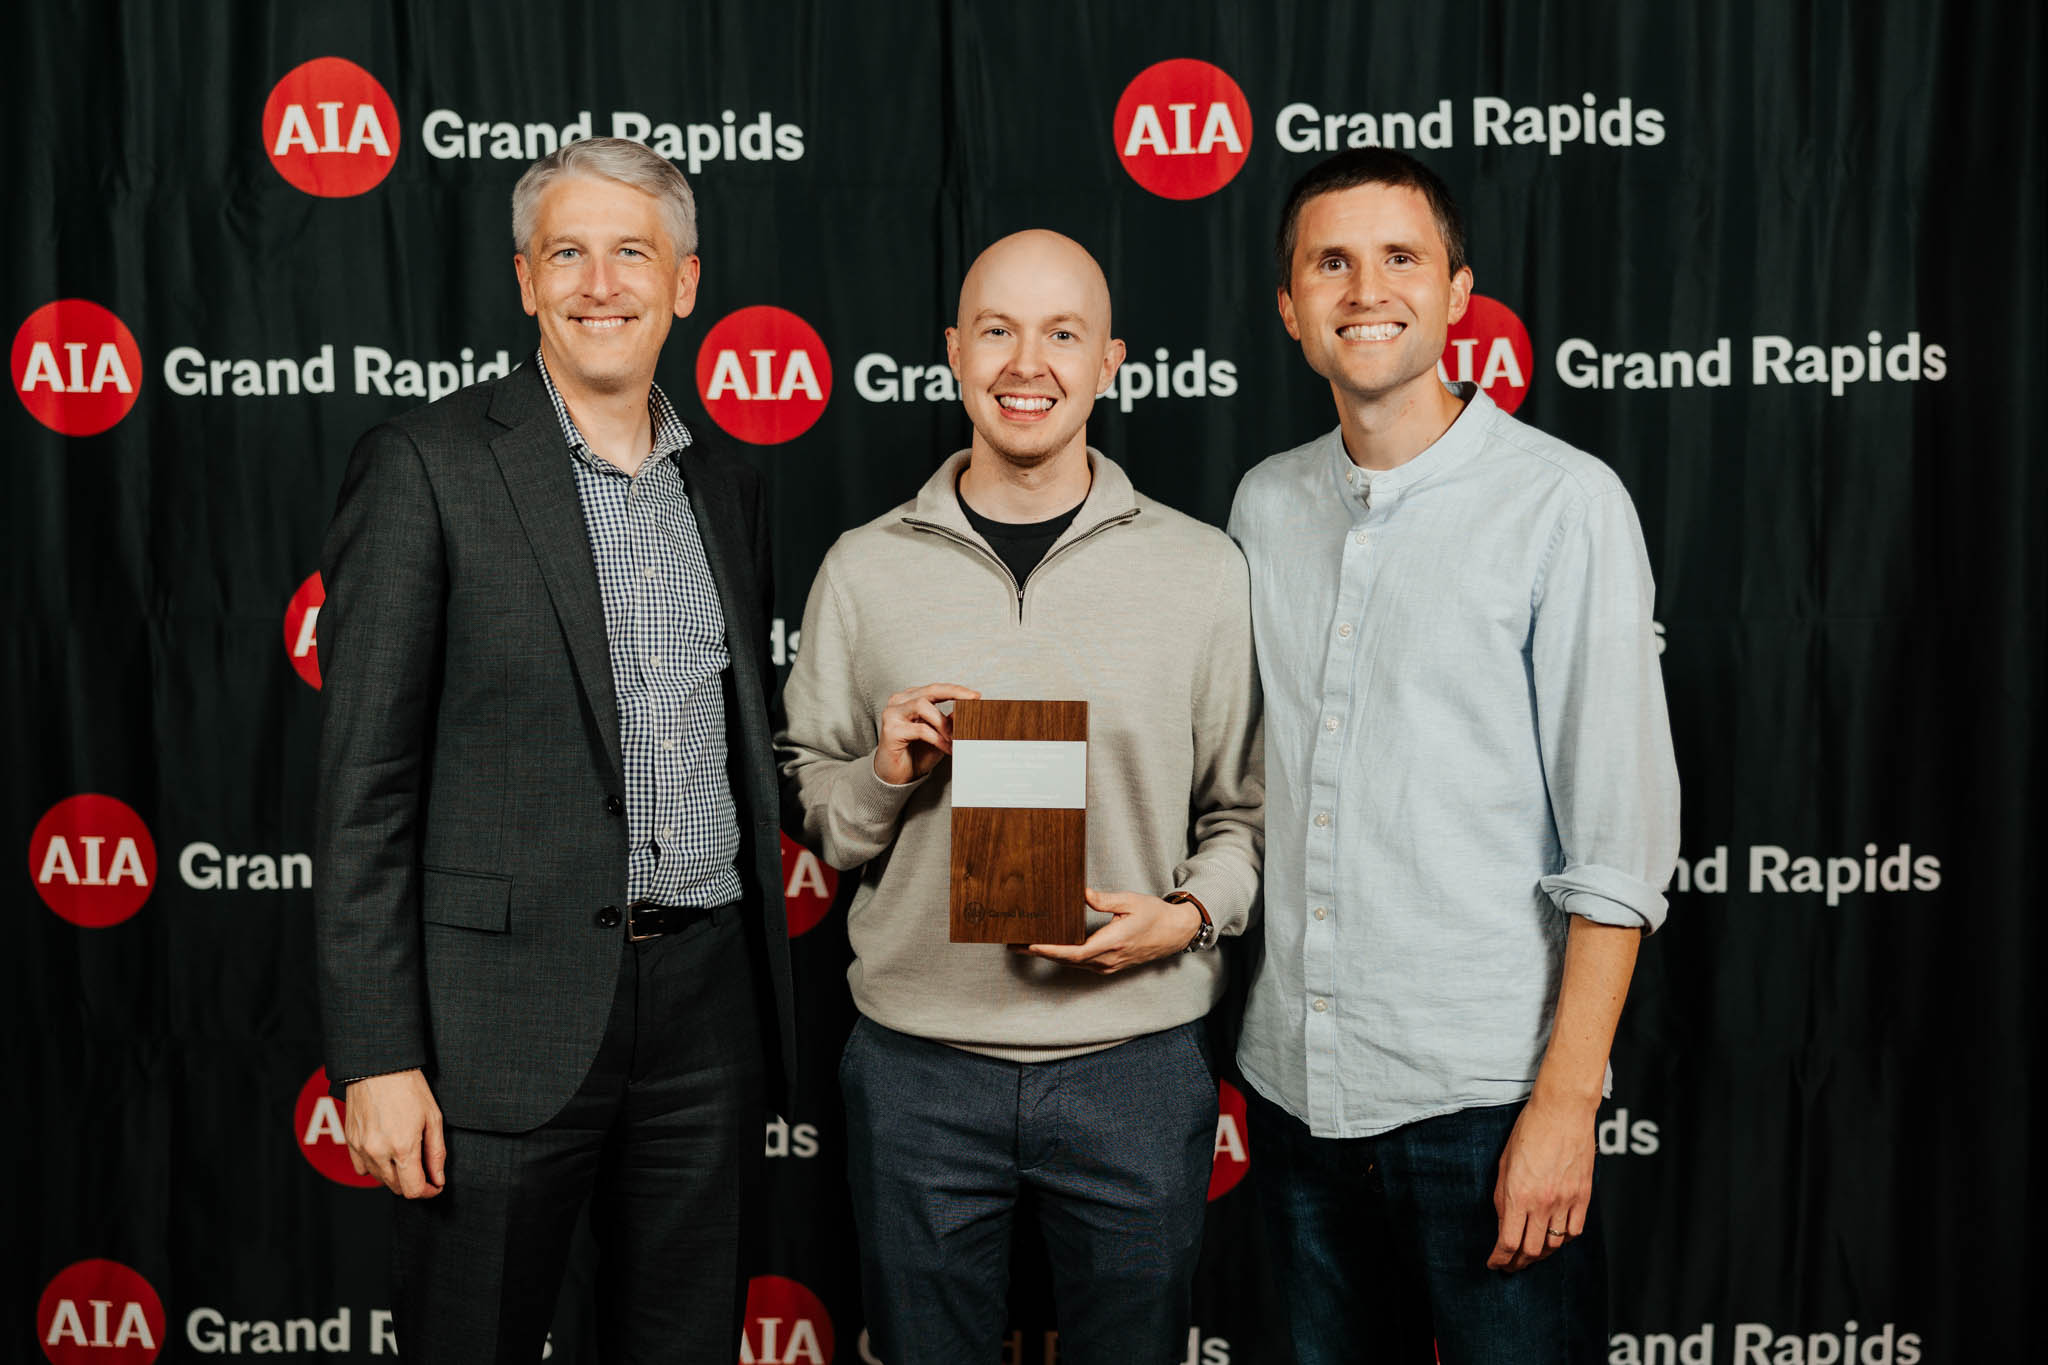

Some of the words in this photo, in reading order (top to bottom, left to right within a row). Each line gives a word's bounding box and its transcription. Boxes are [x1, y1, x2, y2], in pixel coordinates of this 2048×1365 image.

[273, 101, 392, 157] AIA
[611, 109, 805, 174] Rapids
[1124, 102, 1243, 157] AIA
[1275, 99, 1453, 152] Grand
[1473, 92, 1666, 156] Rapids
[21, 341, 133, 394] AIA
[163, 344, 336, 397] Grand
[353, 345, 525, 404] Rapid
[706, 349, 823, 401] AIA
[854, 352, 963, 402] Gra
[1437, 336, 1525, 388] IA
[1555, 337, 1731, 390] Grand
[1752, 330, 1947, 397] Rapids
[39, 835, 148, 887] AIA
[179, 841, 313, 890] Gran
[1749, 843, 1941, 907] Rapids
[47, 1299, 155, 1349] AIA
[186, 1307, 351, 1354] Grand
[1608, 1323, 1714, 1365] and
[1733, 1320, 1921, 1365] Rapids
